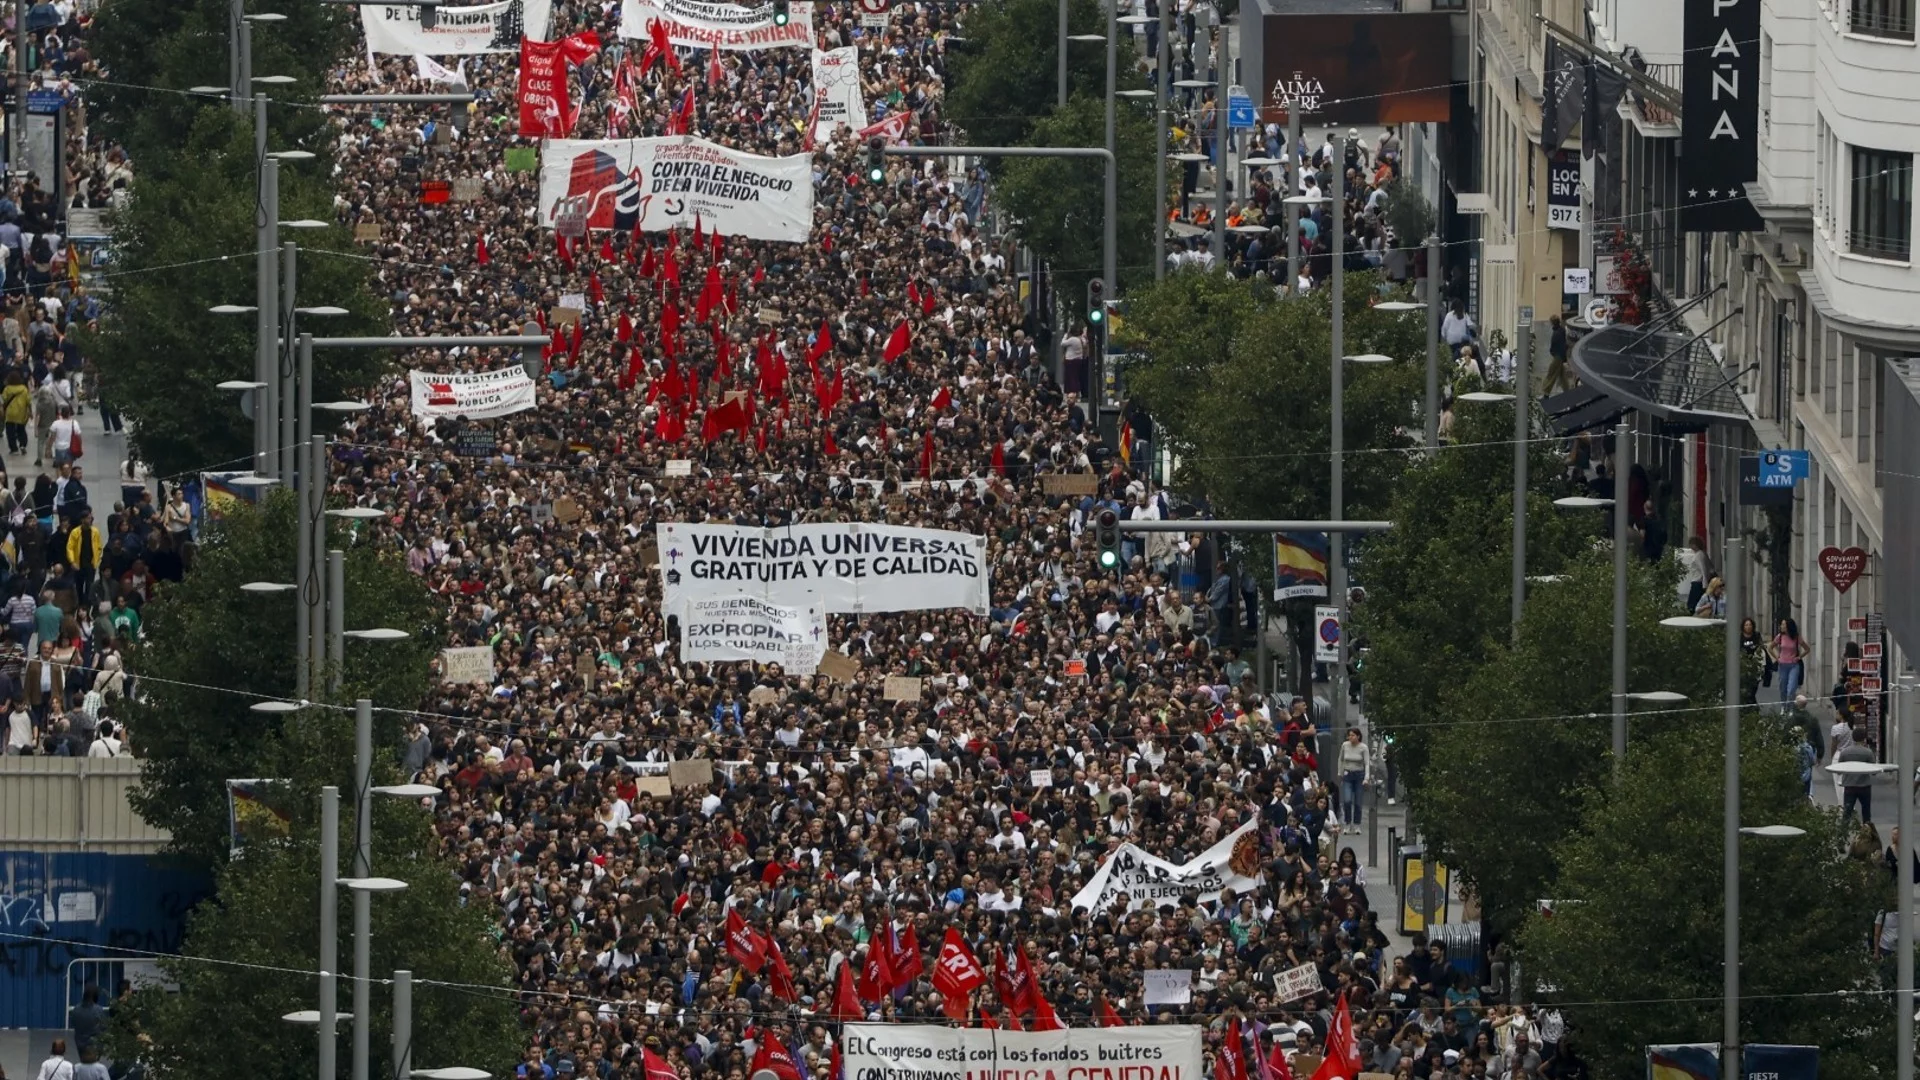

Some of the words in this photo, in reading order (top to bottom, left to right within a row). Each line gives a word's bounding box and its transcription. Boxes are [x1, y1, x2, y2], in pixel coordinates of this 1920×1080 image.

[433, 12, 490, 25] IVIENDA
[646, 18, 723, 45] GRANTIZAR
[728, 30, 744, 44] LA
[528, 79, 552, 91] CLASE
[1272, 79, 1325, 95] ALMA
[653, 149, 691, 161] juventud
[652, 161, 710, 179] CONTRA
[712, 165, 729, 182] EL
[731, 169, 792, 192] NEGOCIO
[1553, 169, 1580, 182] LOC
[652, 179, 671, 193] DE
[672, 178, 691, 192] LA
[694, 182, 759, 201] VIVIENDA
[1552, 183, 1570, 196] EN
[1552, 208, 1571, 221] 917
[423, 367, 523, 384] UNIVERSITARIO
[458, 395, 502, 408] PÚBLICA
[1778, 454, 1793, 473] S
[1765, 474, 1792, 485] ATM
[690, 533, 815, 559] VIVIENDA
[821, 532, 975, 560] UNIVERSAL
[690, 558, 808, 582] GRATUITA
[813, 559, 828, 577] Y
[835, 558, 866, 578] DE
[872, 556, 979, 578] CALIDAD
[695, 600, 718, 610] SUS
[721, 598, 798, 619] BENEFICIOS
[704, 609, 746, 617] NUESTRA
[688, 623, 803, 644] EXPROPIAR
[724, 640, 785, 652] CULPABL
[941, 944, 980, 980] CRT
[866, 1037, 933, 1062] Congreso
[937, 1046, 966, 1062] está
[969, 1048, 997, 1060] con
[1032, 1045, 1089, 1062] fondos
[1098, 1043, 1162, 1060] buitres
[856, 1067, 961, 1080] CONSTRUYAMOS
